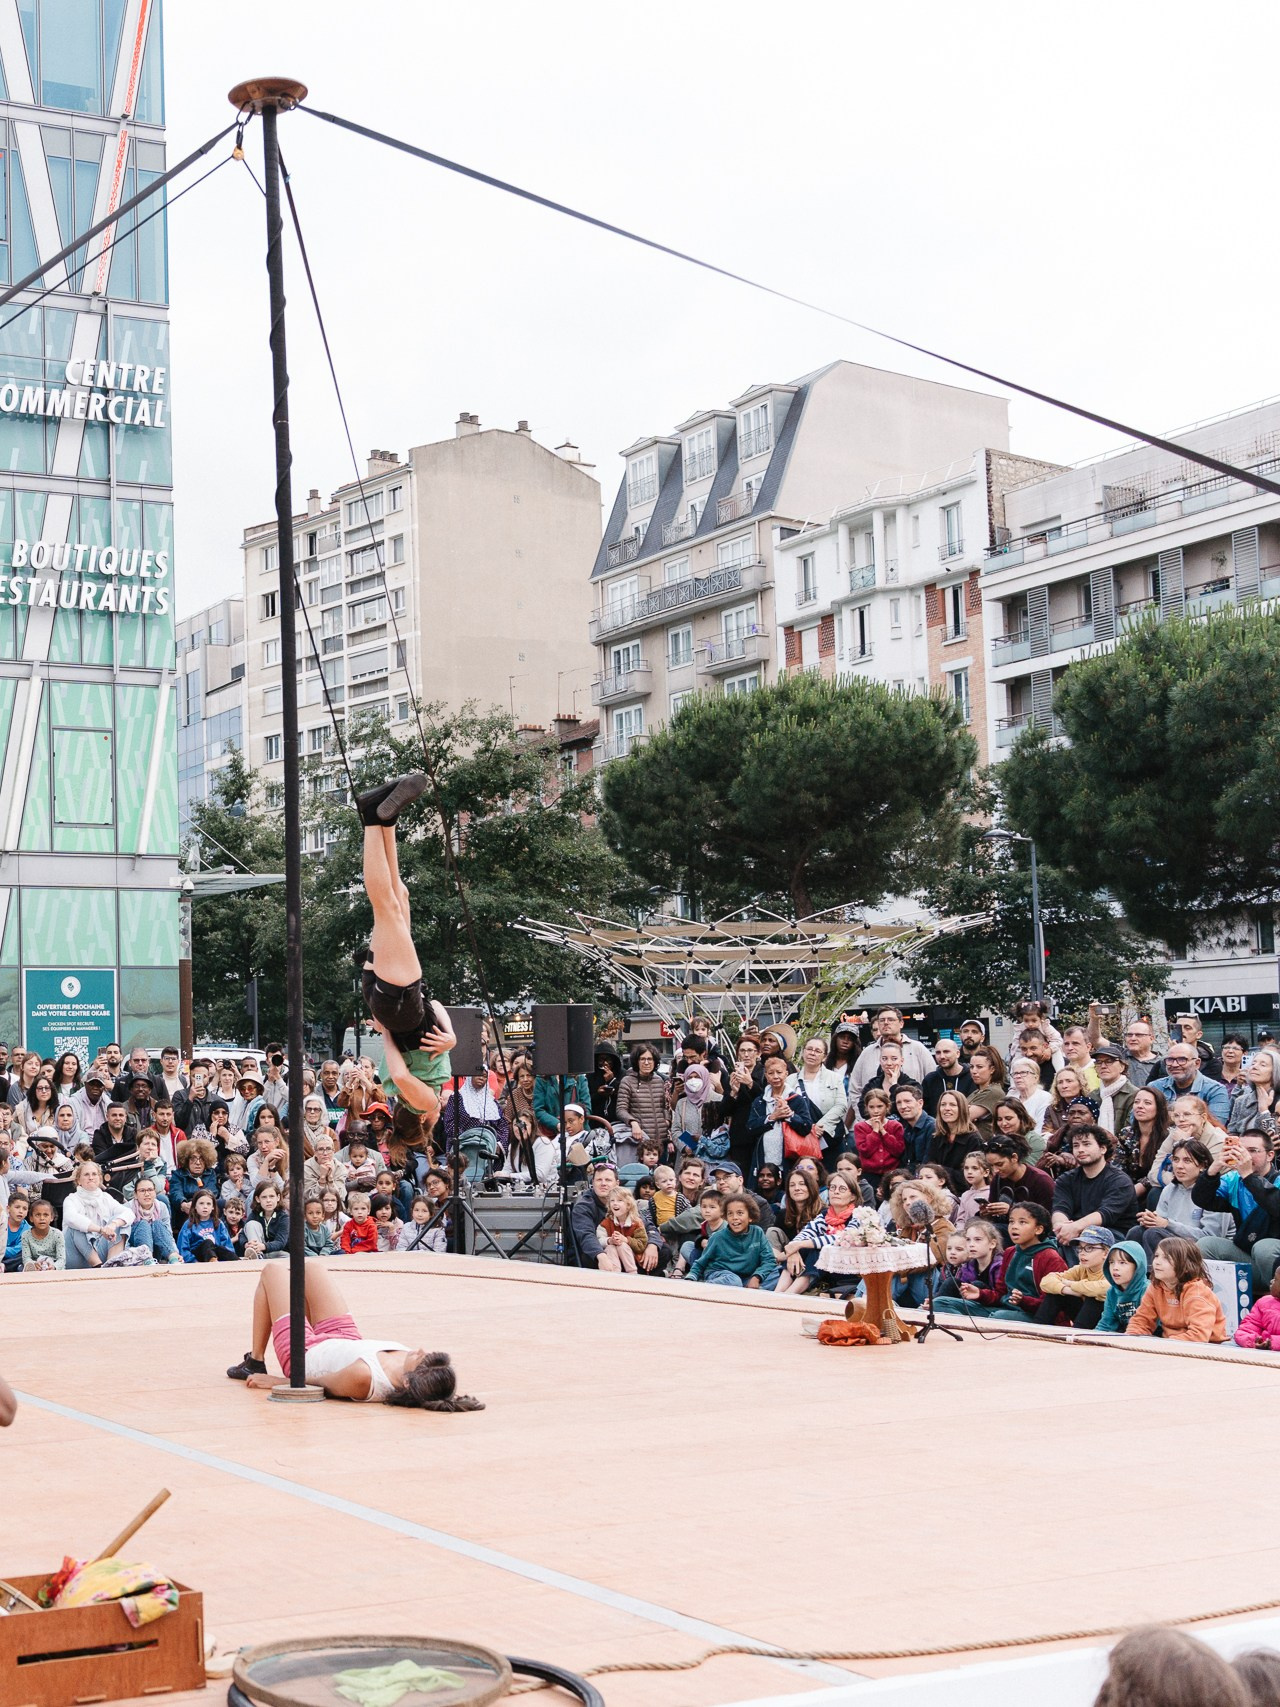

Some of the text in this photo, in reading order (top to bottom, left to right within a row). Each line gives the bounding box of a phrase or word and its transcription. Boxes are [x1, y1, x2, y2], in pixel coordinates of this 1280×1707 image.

[65, 358, 166, 395] CENTRE
[12, 539, 169, 579] BOUTIQUES
[1189, 996, 1247, 1014] KIABI
